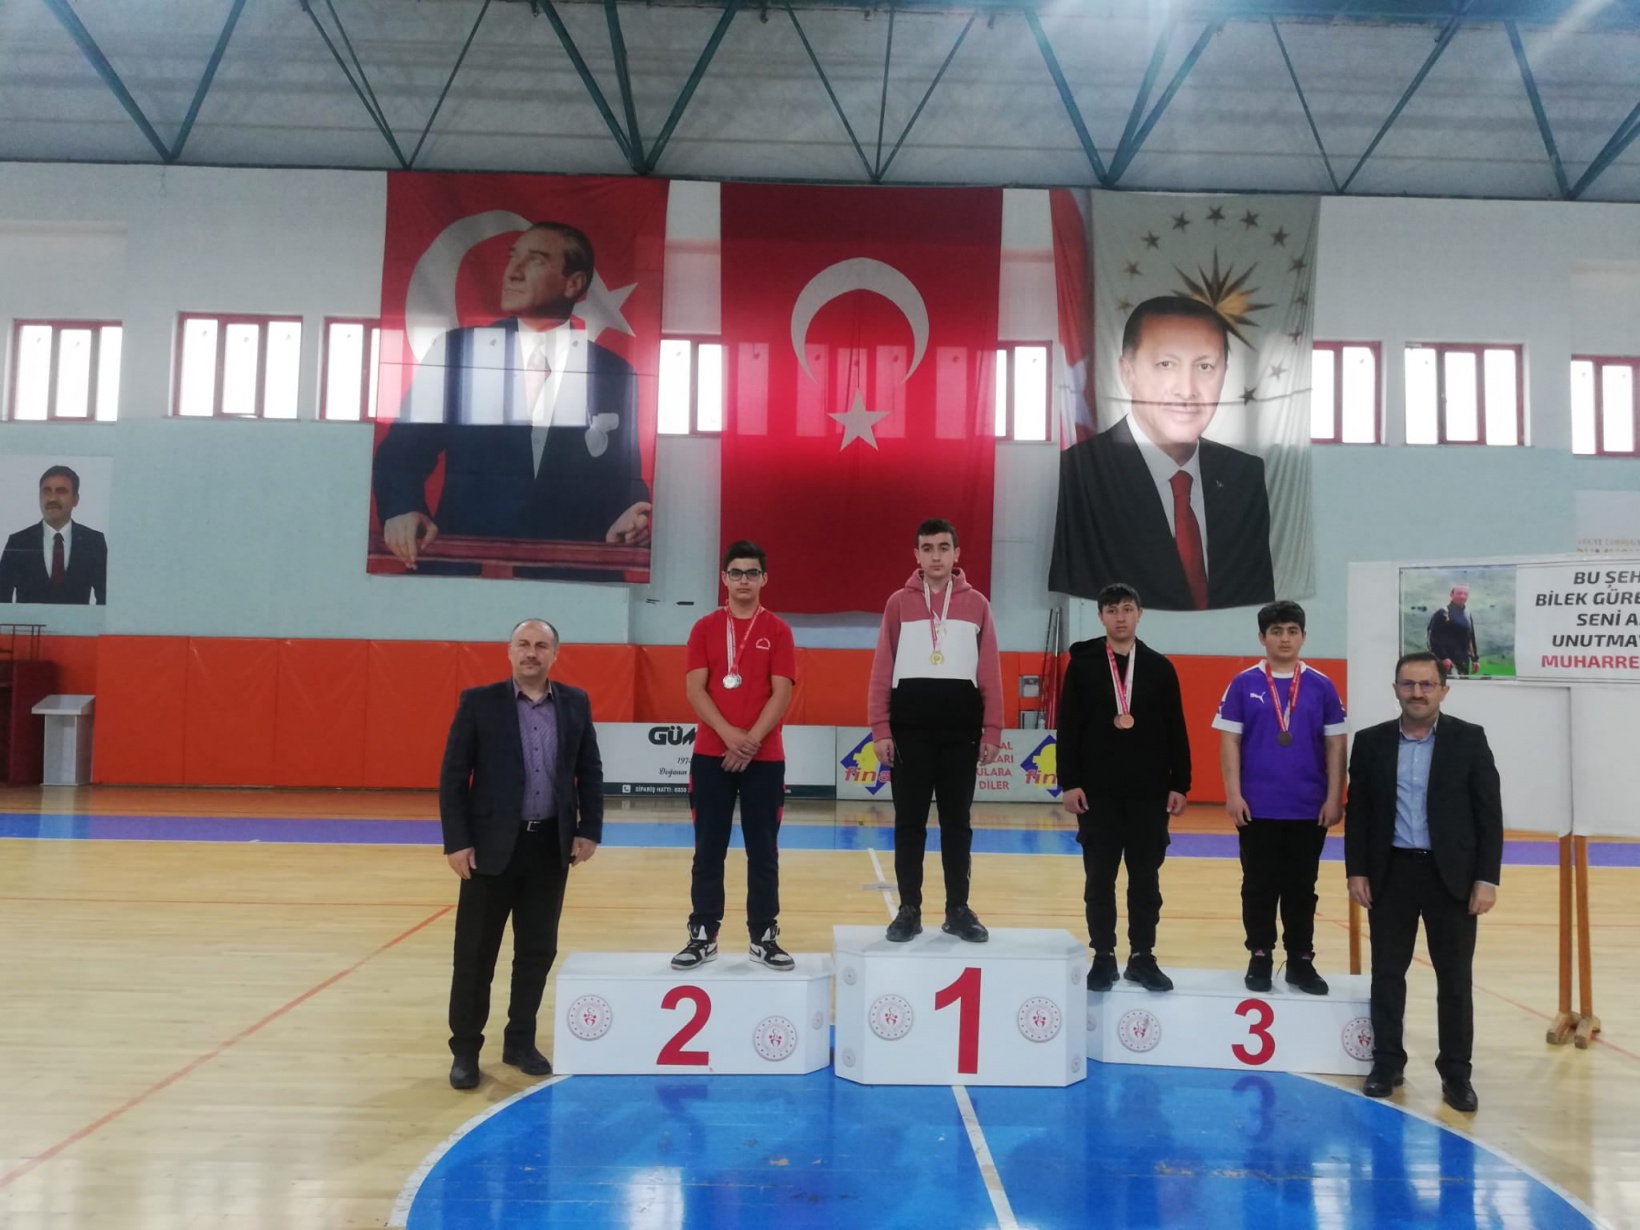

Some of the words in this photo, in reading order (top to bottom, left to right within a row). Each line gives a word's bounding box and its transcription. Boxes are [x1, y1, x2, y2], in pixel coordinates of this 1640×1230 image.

[1573, 571, 1600, 585] BU
[1604, 570, 1640, 588] ŞEH
[1535, 590, 1588, 607] BİLEK
[1576, 609, 1621, 626] SENİ
[1552, 634, 1640, 648] UNUTMA
[1541, 655, 1640, 669] MUHARRE
[656, 985, 712, 1065] 2
[935, 967, 982, 1074] 1
[1231, 998, 1276, 1066] 3
